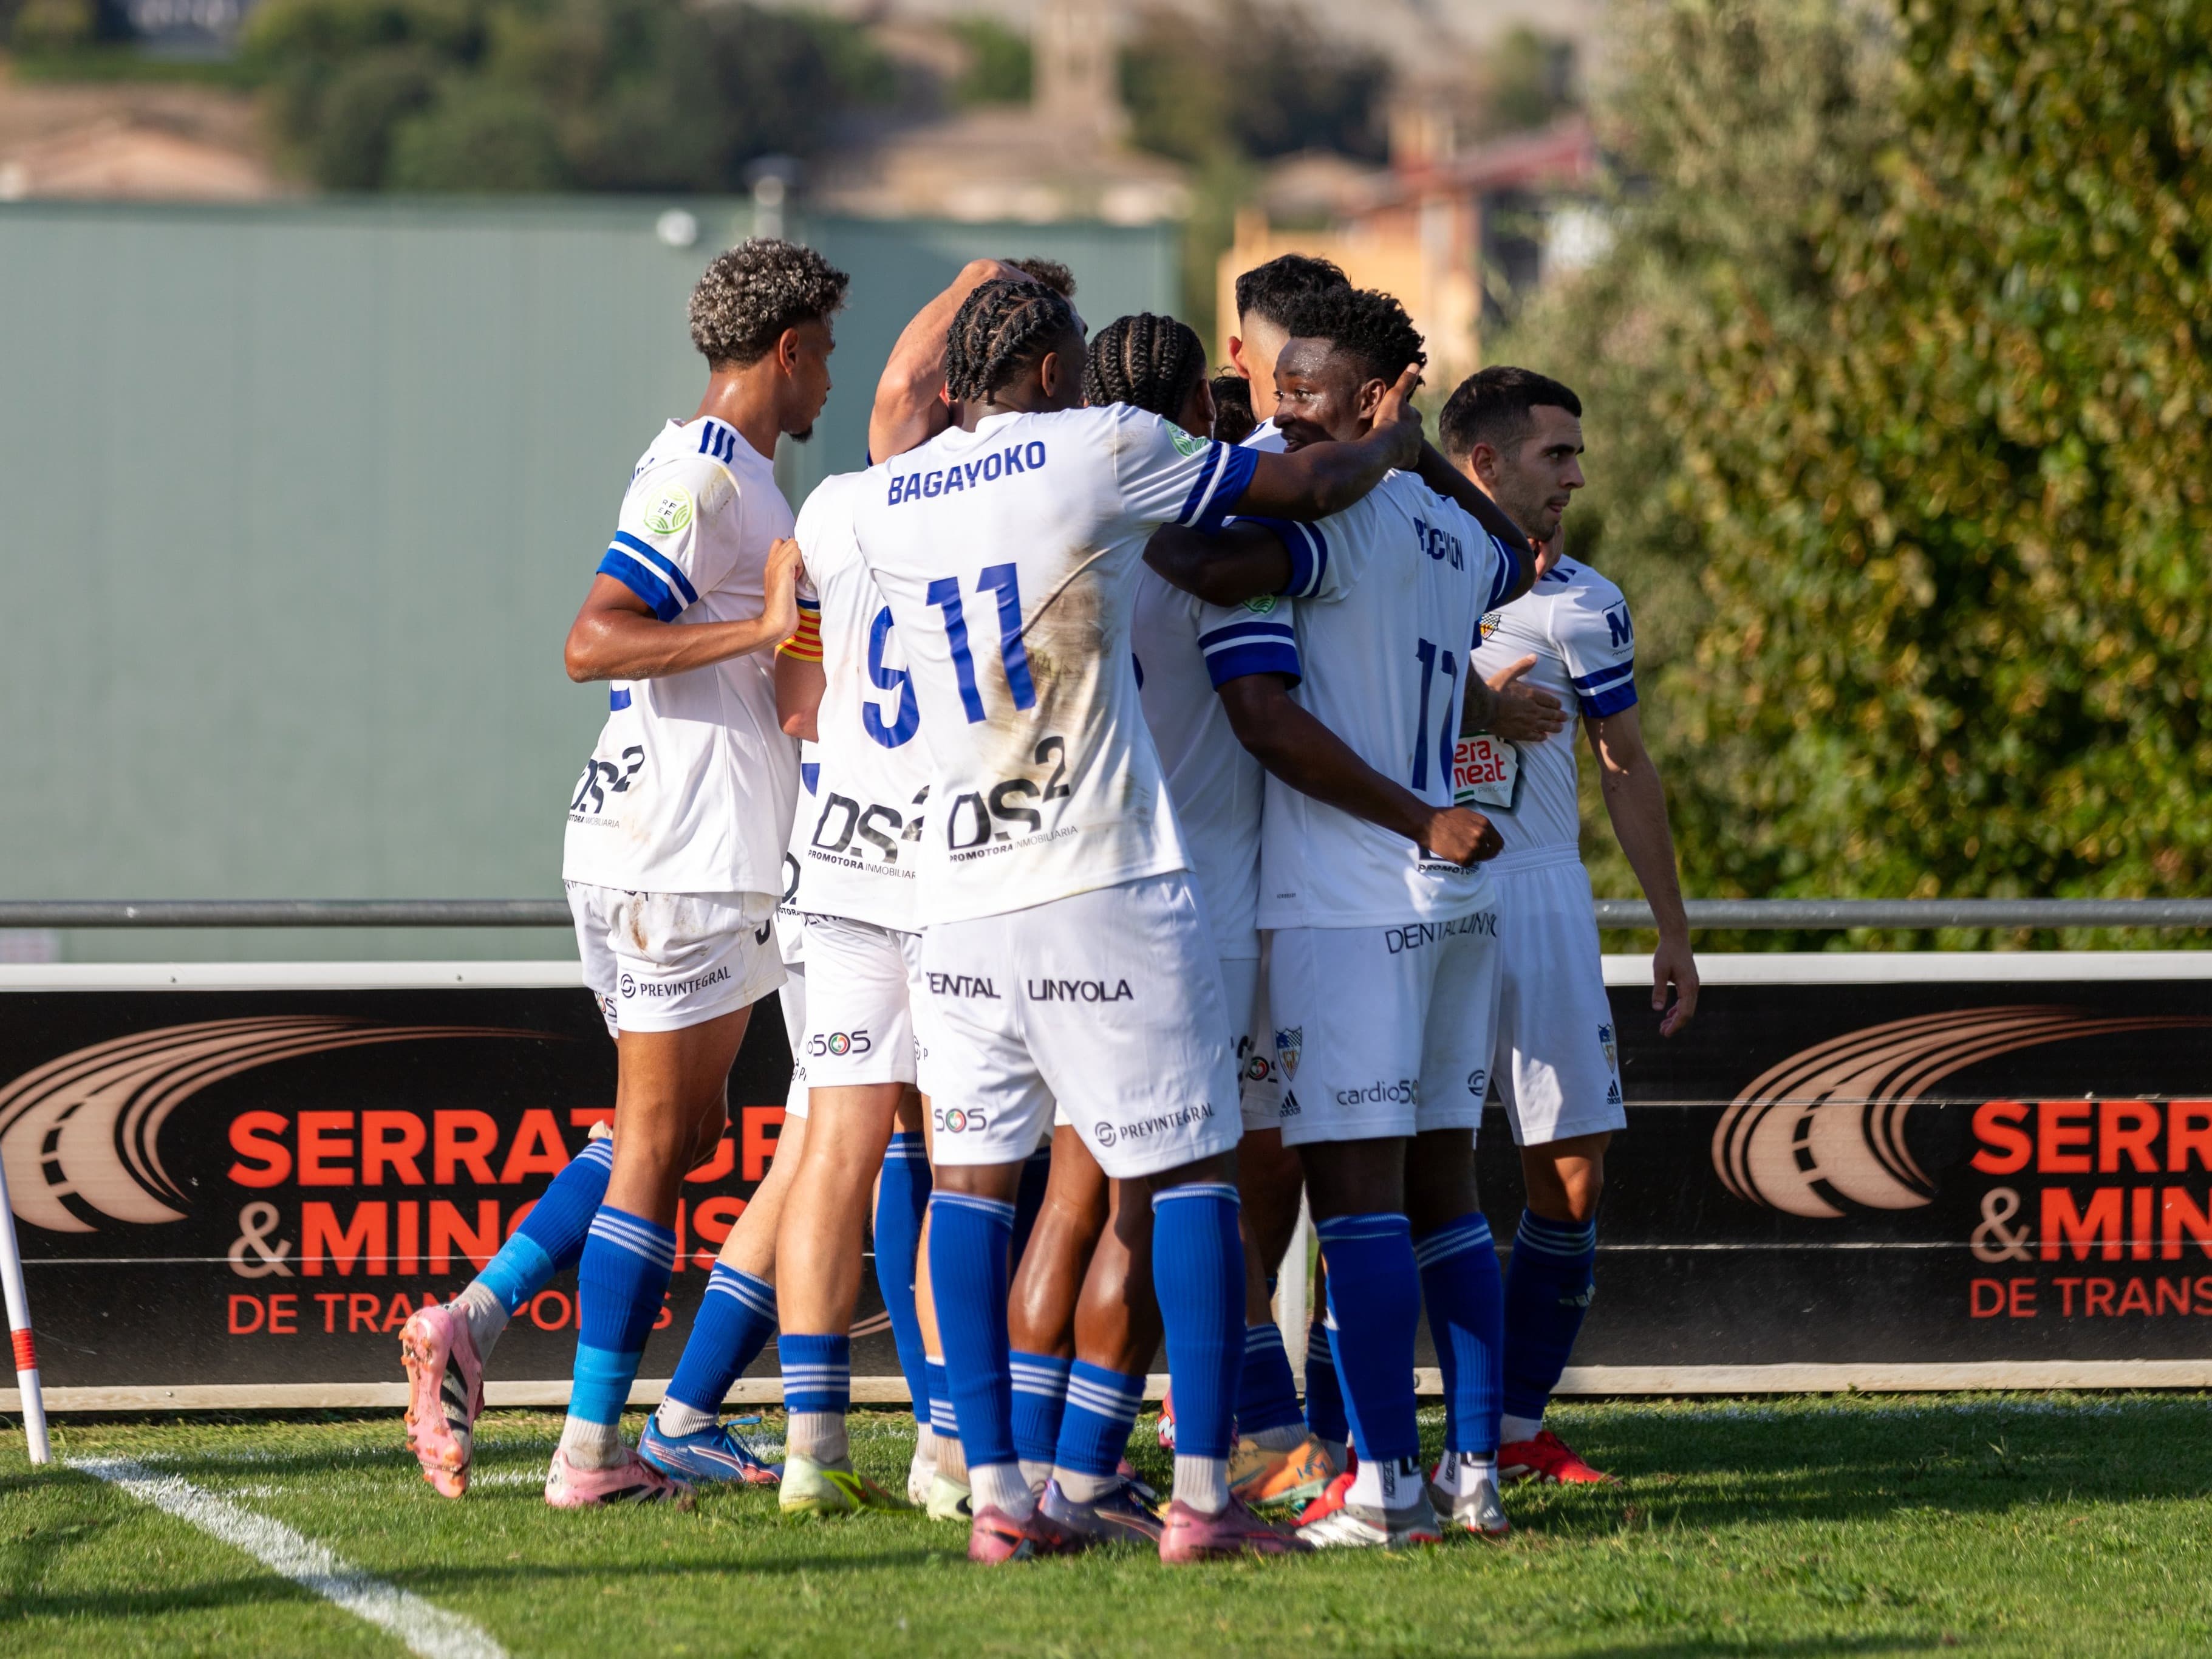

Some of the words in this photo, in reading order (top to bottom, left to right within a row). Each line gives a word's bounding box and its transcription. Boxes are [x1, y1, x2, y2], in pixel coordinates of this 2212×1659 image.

[887, 440, 1046, 506] BAGAYOKO
[926, 562, 1036, 725] 11
[808, 849, 864, 871] PROMOTORA
[949, 843, 1013, 863] PROMOTORA
[1014, 826, 1079, 849] INMOBILIARIA
[640, 966, 731, 997] PREVINTEGRAL
[926, 972, 1001, 1000] ENTAL
[1028, 979, 1134, 1003] LINYOLA
[1119, 1103, 1215, 1140] PREVINTEGRAL
[228, 1295, 298, 1335] DE
[1970, 1278, 2037, 1318] DE
